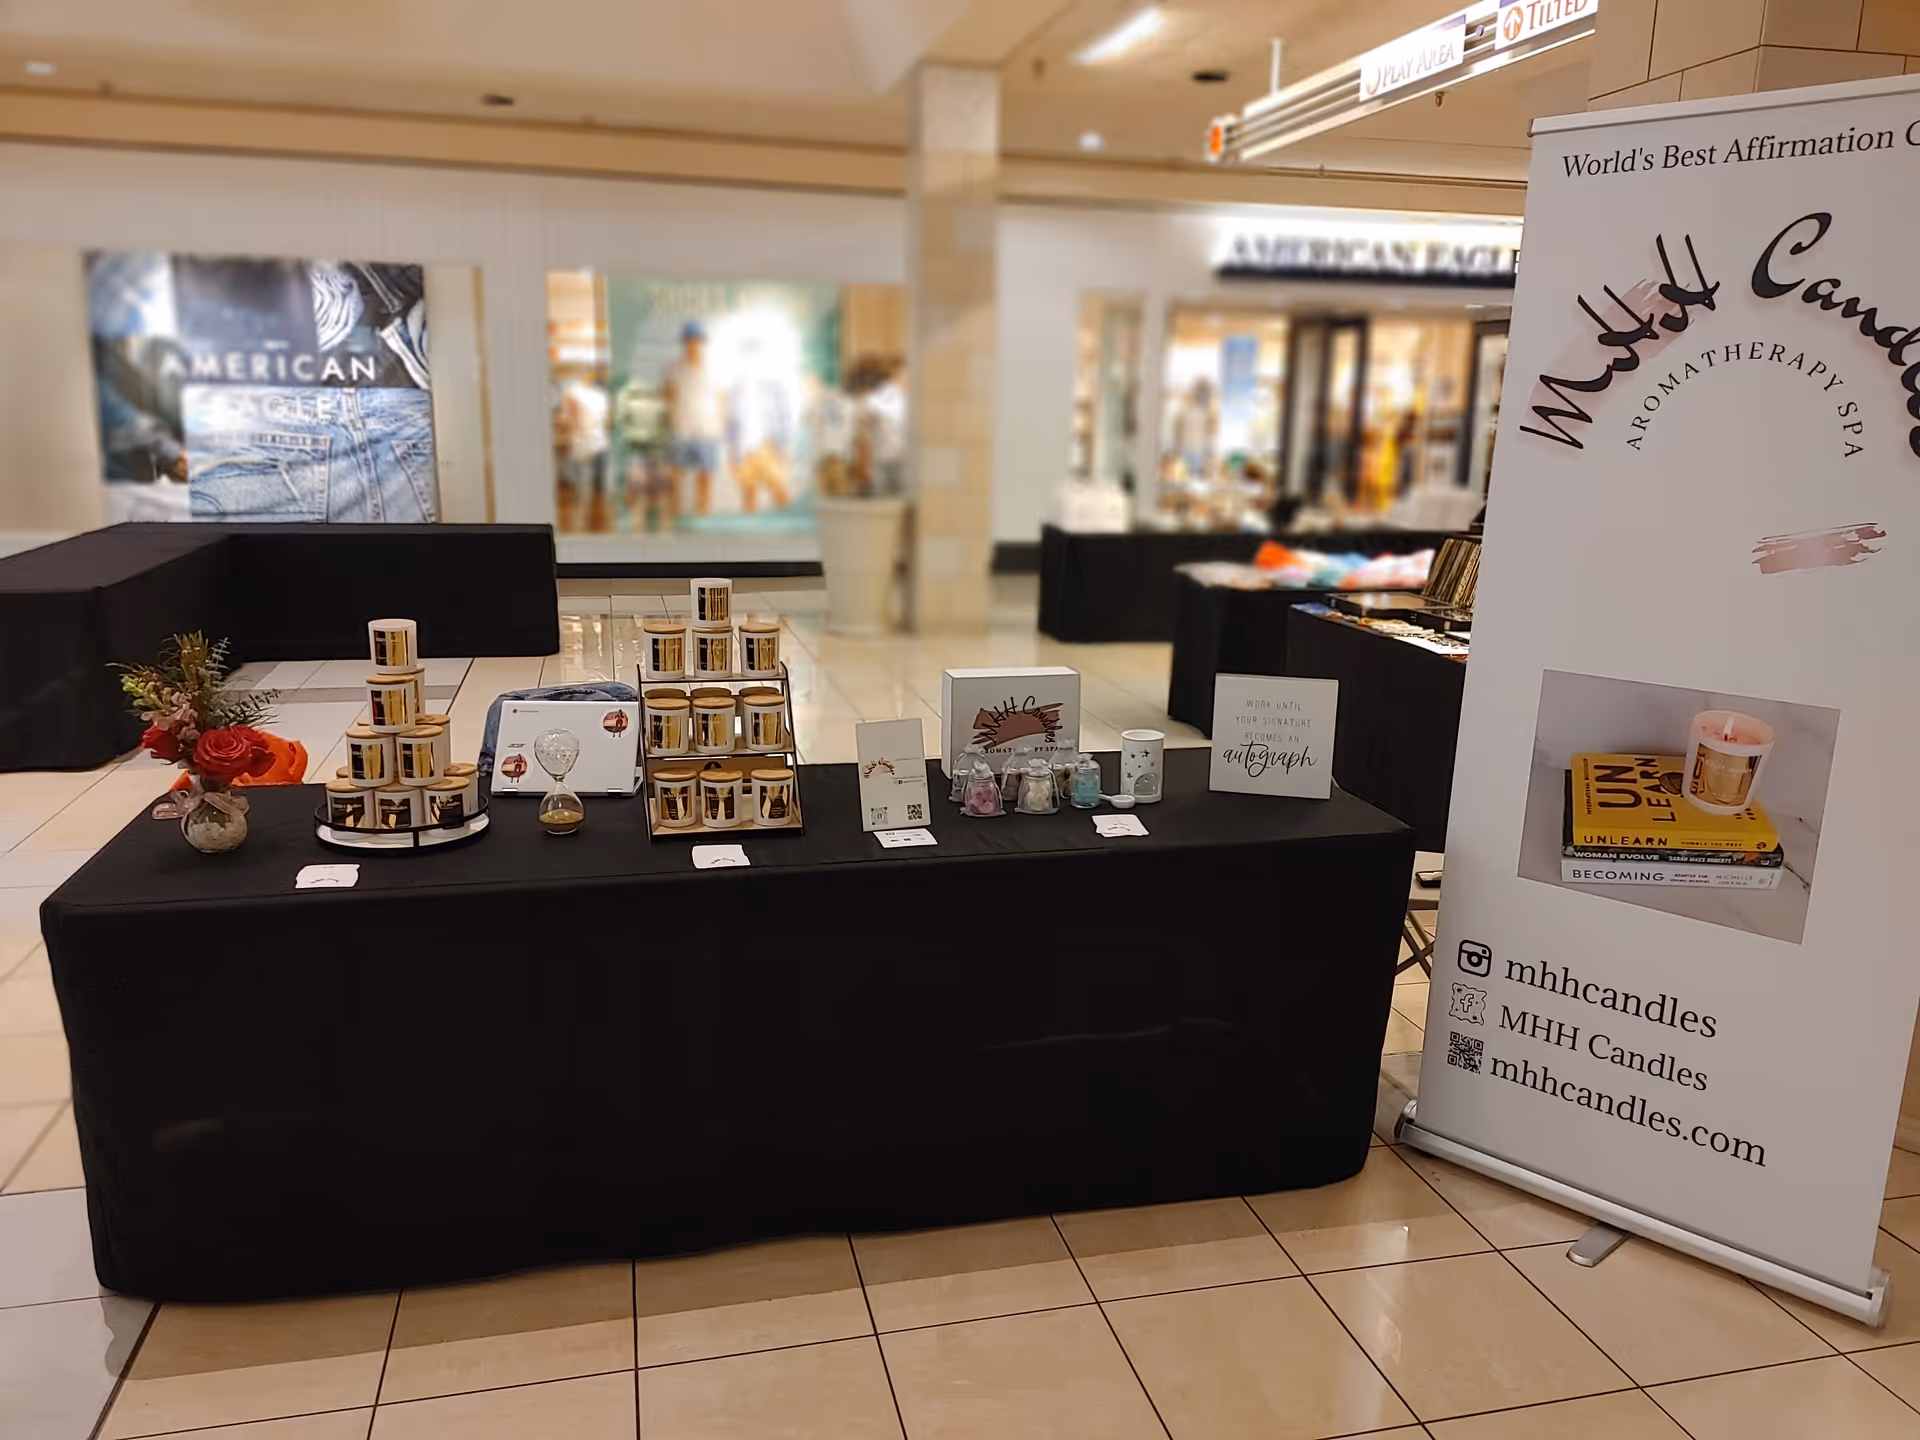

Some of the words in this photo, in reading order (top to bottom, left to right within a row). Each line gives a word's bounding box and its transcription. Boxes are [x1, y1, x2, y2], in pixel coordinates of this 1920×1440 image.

[1526, 0, 1588, 30] TILTED
[1382, 57, 1414, 87] PLAY
[1416, 41, 1456, 74] AREA
[1561, 146, 1654, 179] World's
[1662, 144, 1718, 170] Best
[1722, 127, 1895, 164] Affirmation
[160, 352, 376, 382] AMERICAN
[1626, 341, 1845, 451] AROMATHERAPY
[1837, 401, 1864, 458] SPA
[1235, 715, 1258, 724] YOUR
[1263, 718, 1312, 728] SIGNATURE
[1246, 699, 1271, 709] WORK
[1276, 702, 1302, 711] UNTIL
[1244, 732, 1283, 742] BECOMES
[1288, 735, 1300, 744] AN
[1222, 740, 1319, 778] autograph
[1593, 763, 1643, 809] UN
[1634, 757, 1677, 823] LEARN
[1573, 851, 1617, 860] WOMAN
[1619, 853, 1660, 861] EVOLVE
[1583, 834, 1668, 847] UNLEARN
[1572, 869, 1665, 882] BECOMING
[1504, 957, 1718, 1039] mhhcandles
[1498, 1004, 1581, 1052] MHH
[1587, 1033, 1709, 1092] Candles
[1489, 1055, 1768, 1168] mhhcandles.com
